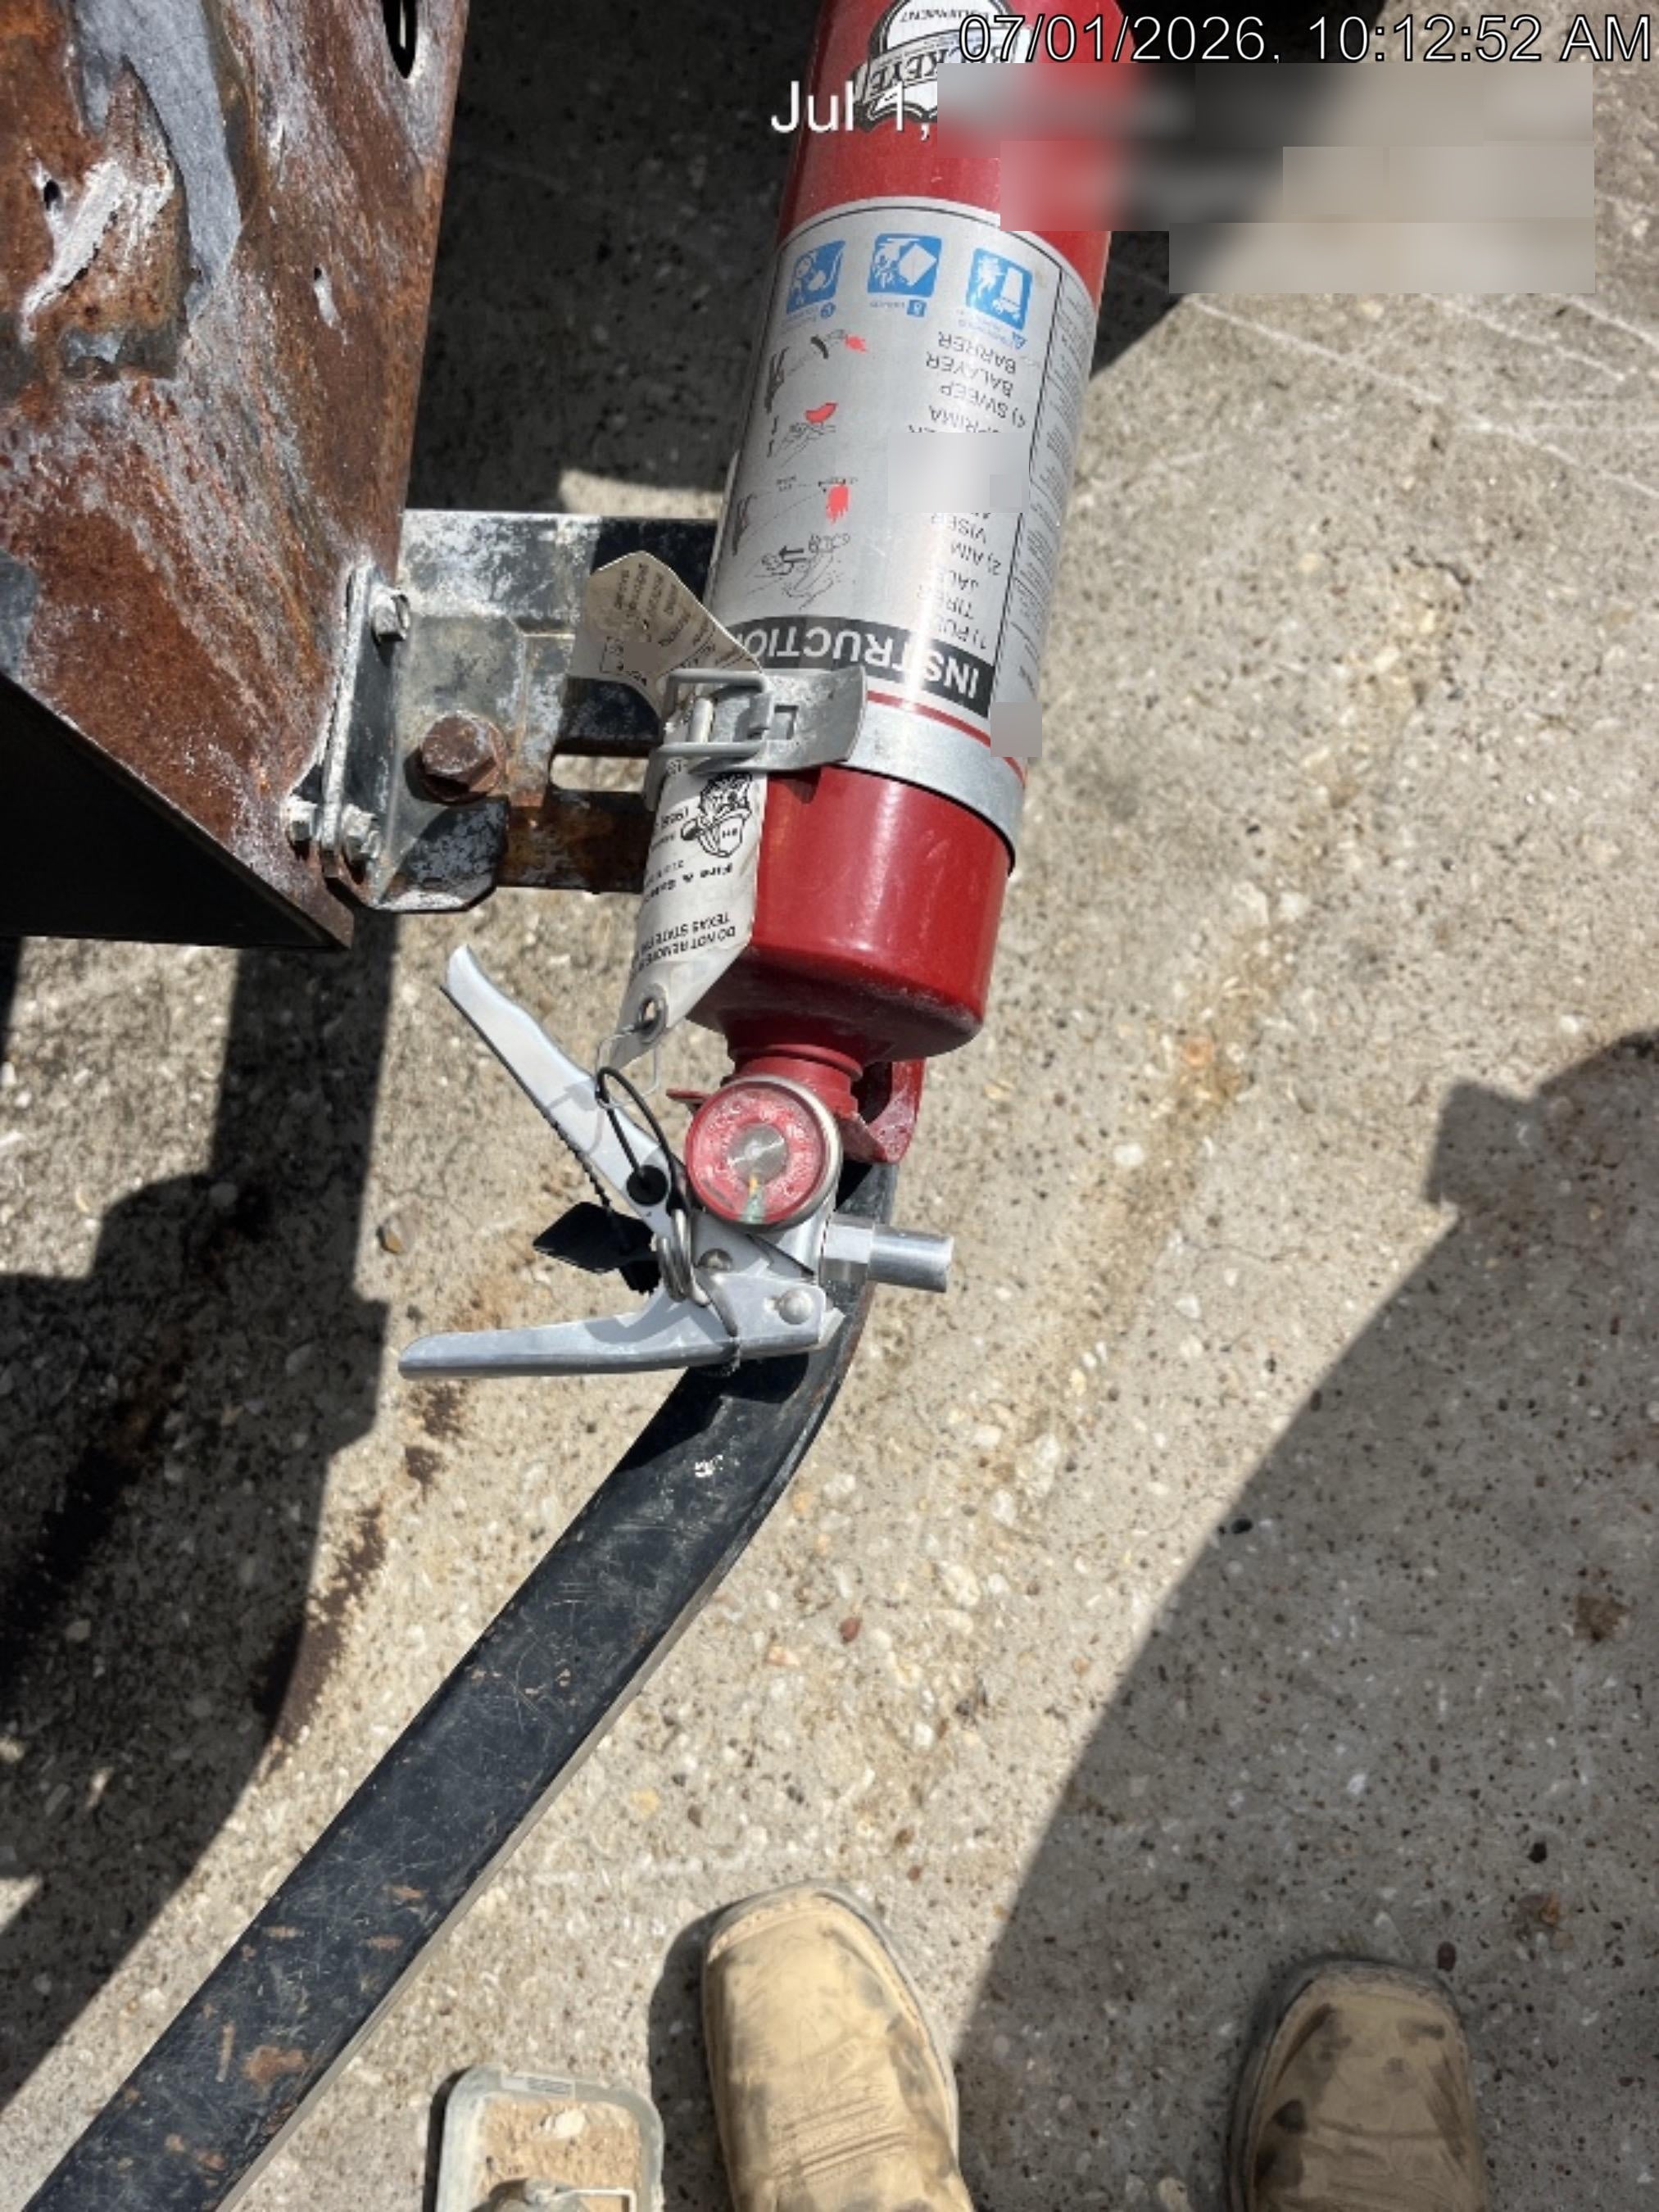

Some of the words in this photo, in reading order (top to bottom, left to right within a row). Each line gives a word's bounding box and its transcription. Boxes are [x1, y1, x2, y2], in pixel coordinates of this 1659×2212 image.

[870, 45, 1003, 93] BCKEYE
[938, 331, 1016, 374] BARRER
[926, 351, 1013, 398] BALAYER
[941, 383, 1008, 418] SWEEP
[950, 541, 985, 565] AIM
[972, 628, 986, 650] 1)
[700, 862, 733, 879] Fire
[692, 911, 730, 931] TEXAS
[656, 922, 688, 945] STATE
[691, 930, 717, 951] NOT
[718, 925, 737, 941] DO
